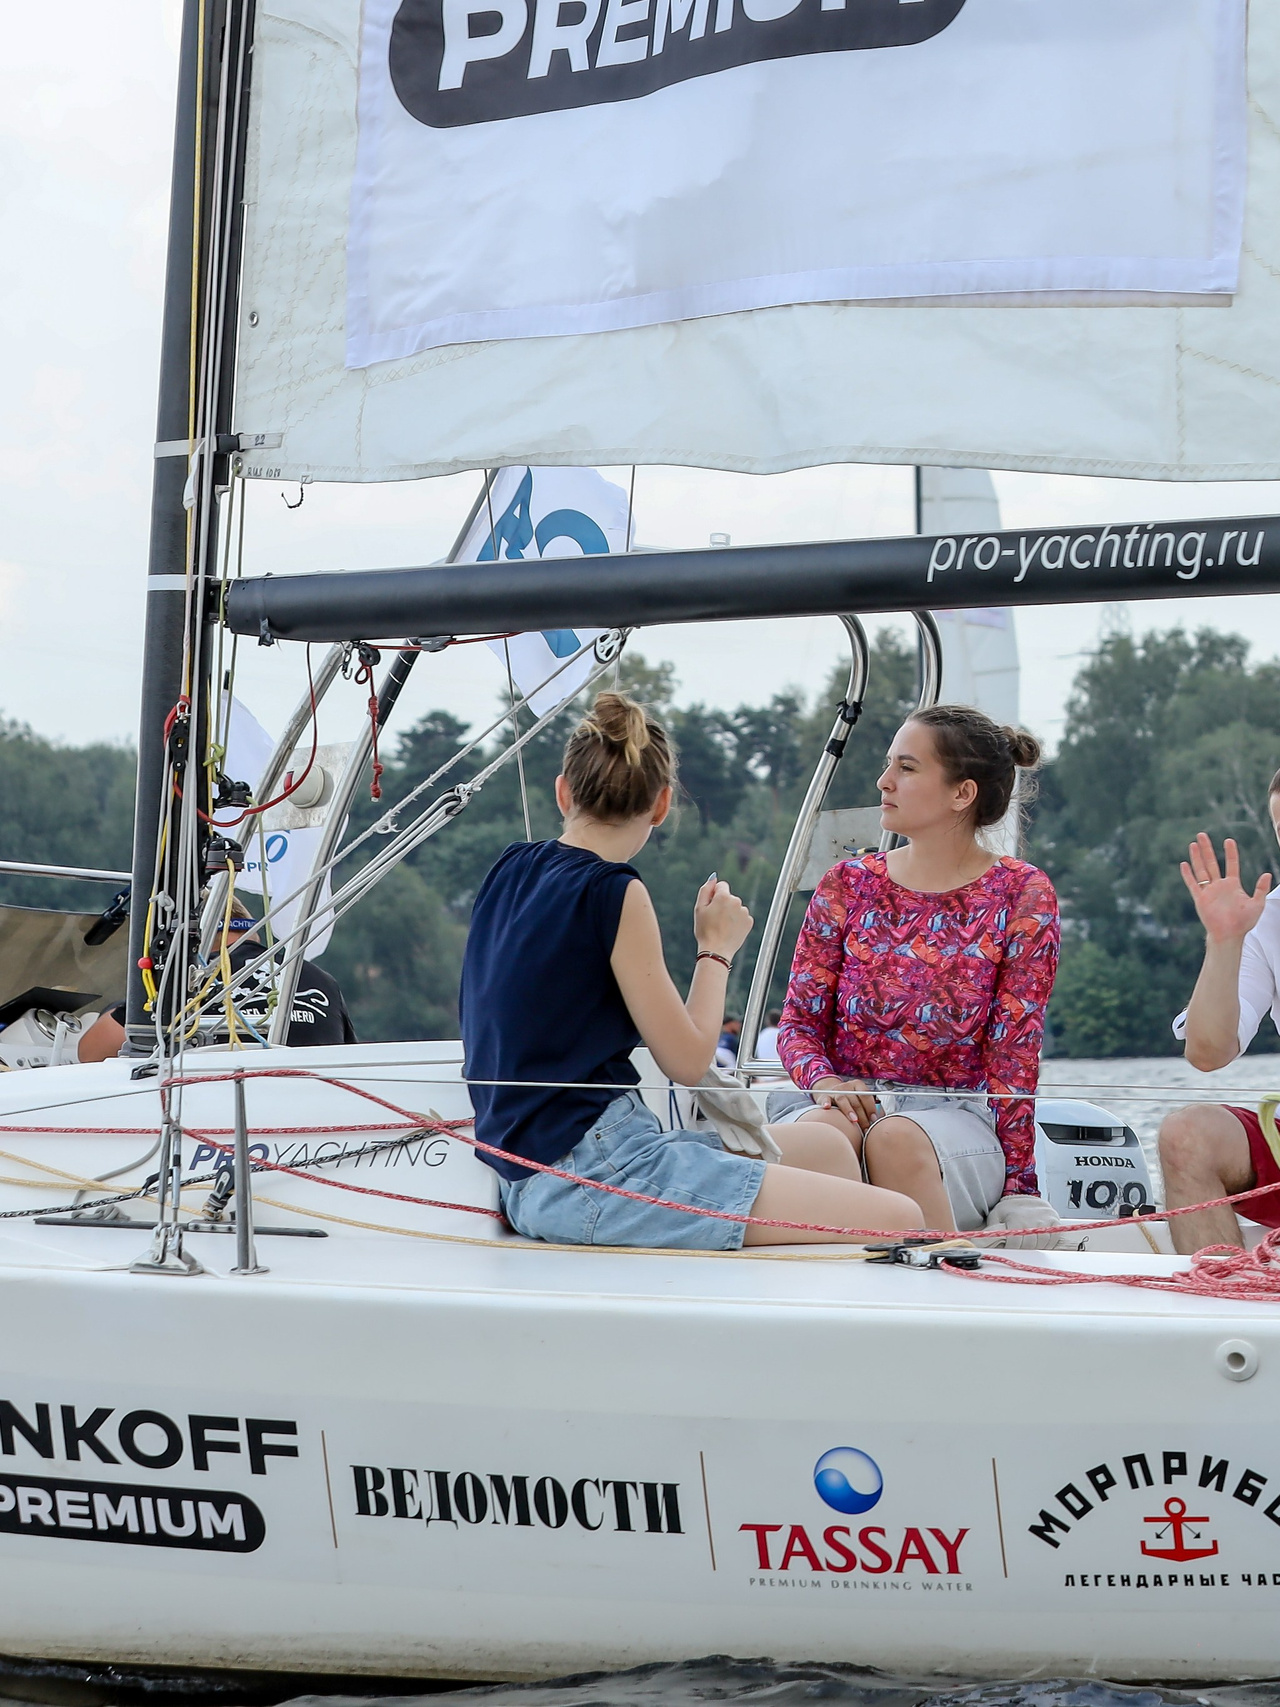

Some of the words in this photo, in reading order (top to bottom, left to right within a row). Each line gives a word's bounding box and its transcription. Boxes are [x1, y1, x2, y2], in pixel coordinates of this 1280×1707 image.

[926, 523, 1266, 583] pro-yachting.ru
[1073, 1156, 1136, 1169] HONDA
[1067, 1180, 1147, 1209] 100
[349, 1465, 686, 1534] ВЕДОМОСТИ
[738, 1524, 971, 1575] TASSAY
[749, 1577, 822, 1588] PREMIUM
[831, 1579, 912, 1591] DRINKING
[922, 1582, 973, 1591] WATER
[1064, 1573, 1230, 1588] ЛЕГЕНДАРНЫЕ
